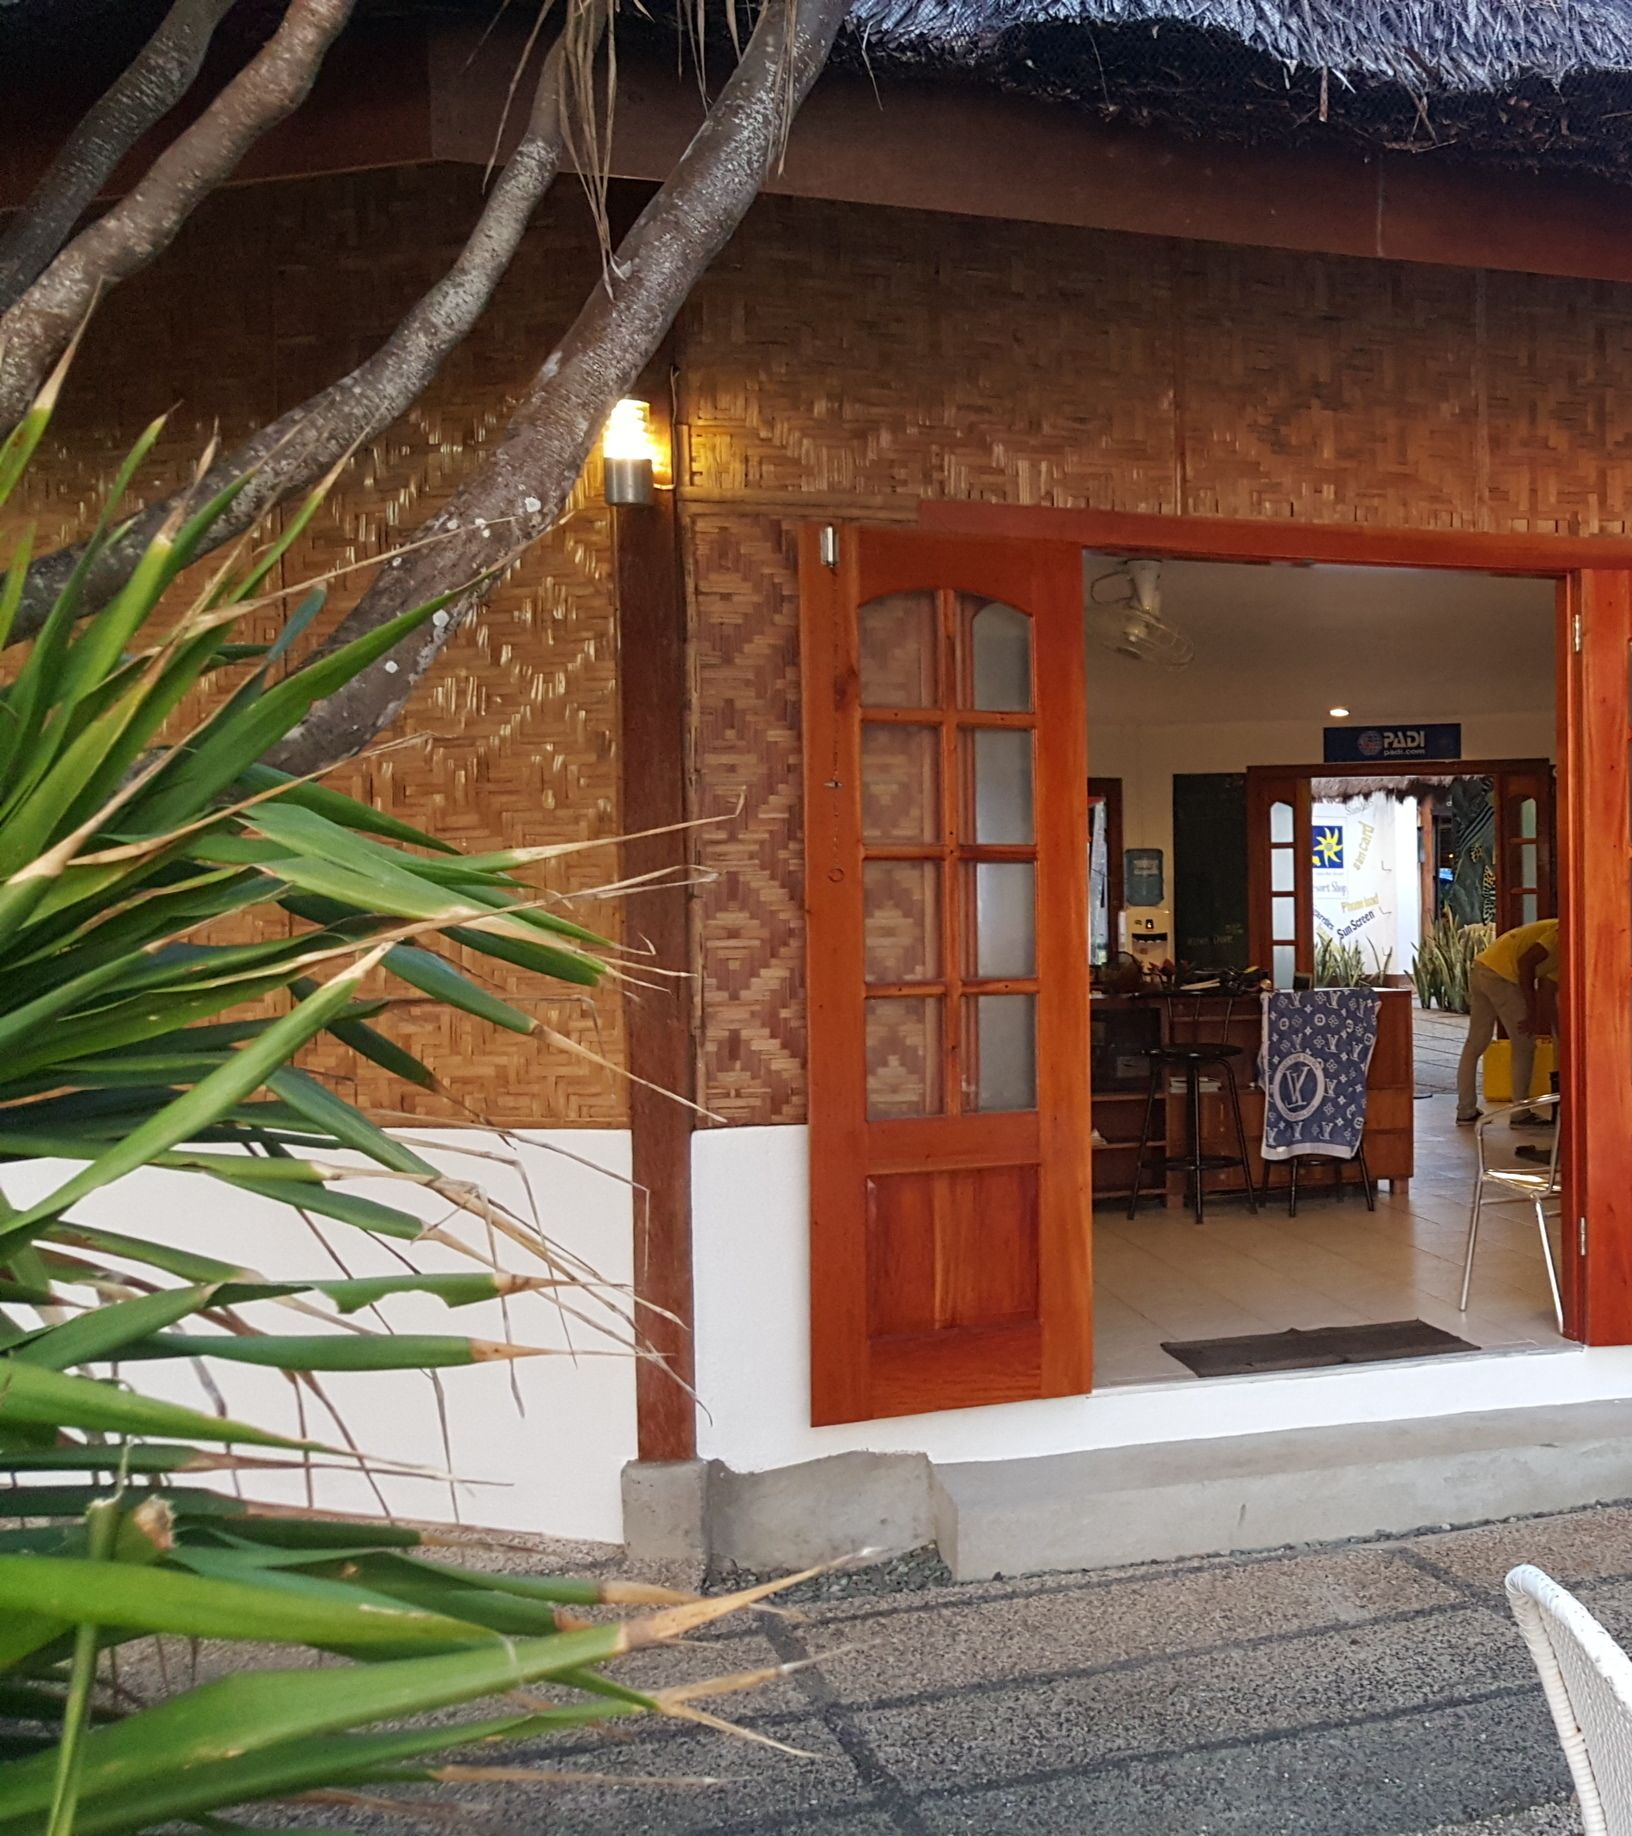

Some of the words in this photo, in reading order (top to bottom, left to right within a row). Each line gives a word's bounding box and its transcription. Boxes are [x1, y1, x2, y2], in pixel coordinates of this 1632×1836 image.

[1383, 730, 1425, 748] PADI
[1383, 748, 1426, 757] padi.com
[1336, 925, 1354, 940] Sun
[1350, 910, 1375, 931] Screen
